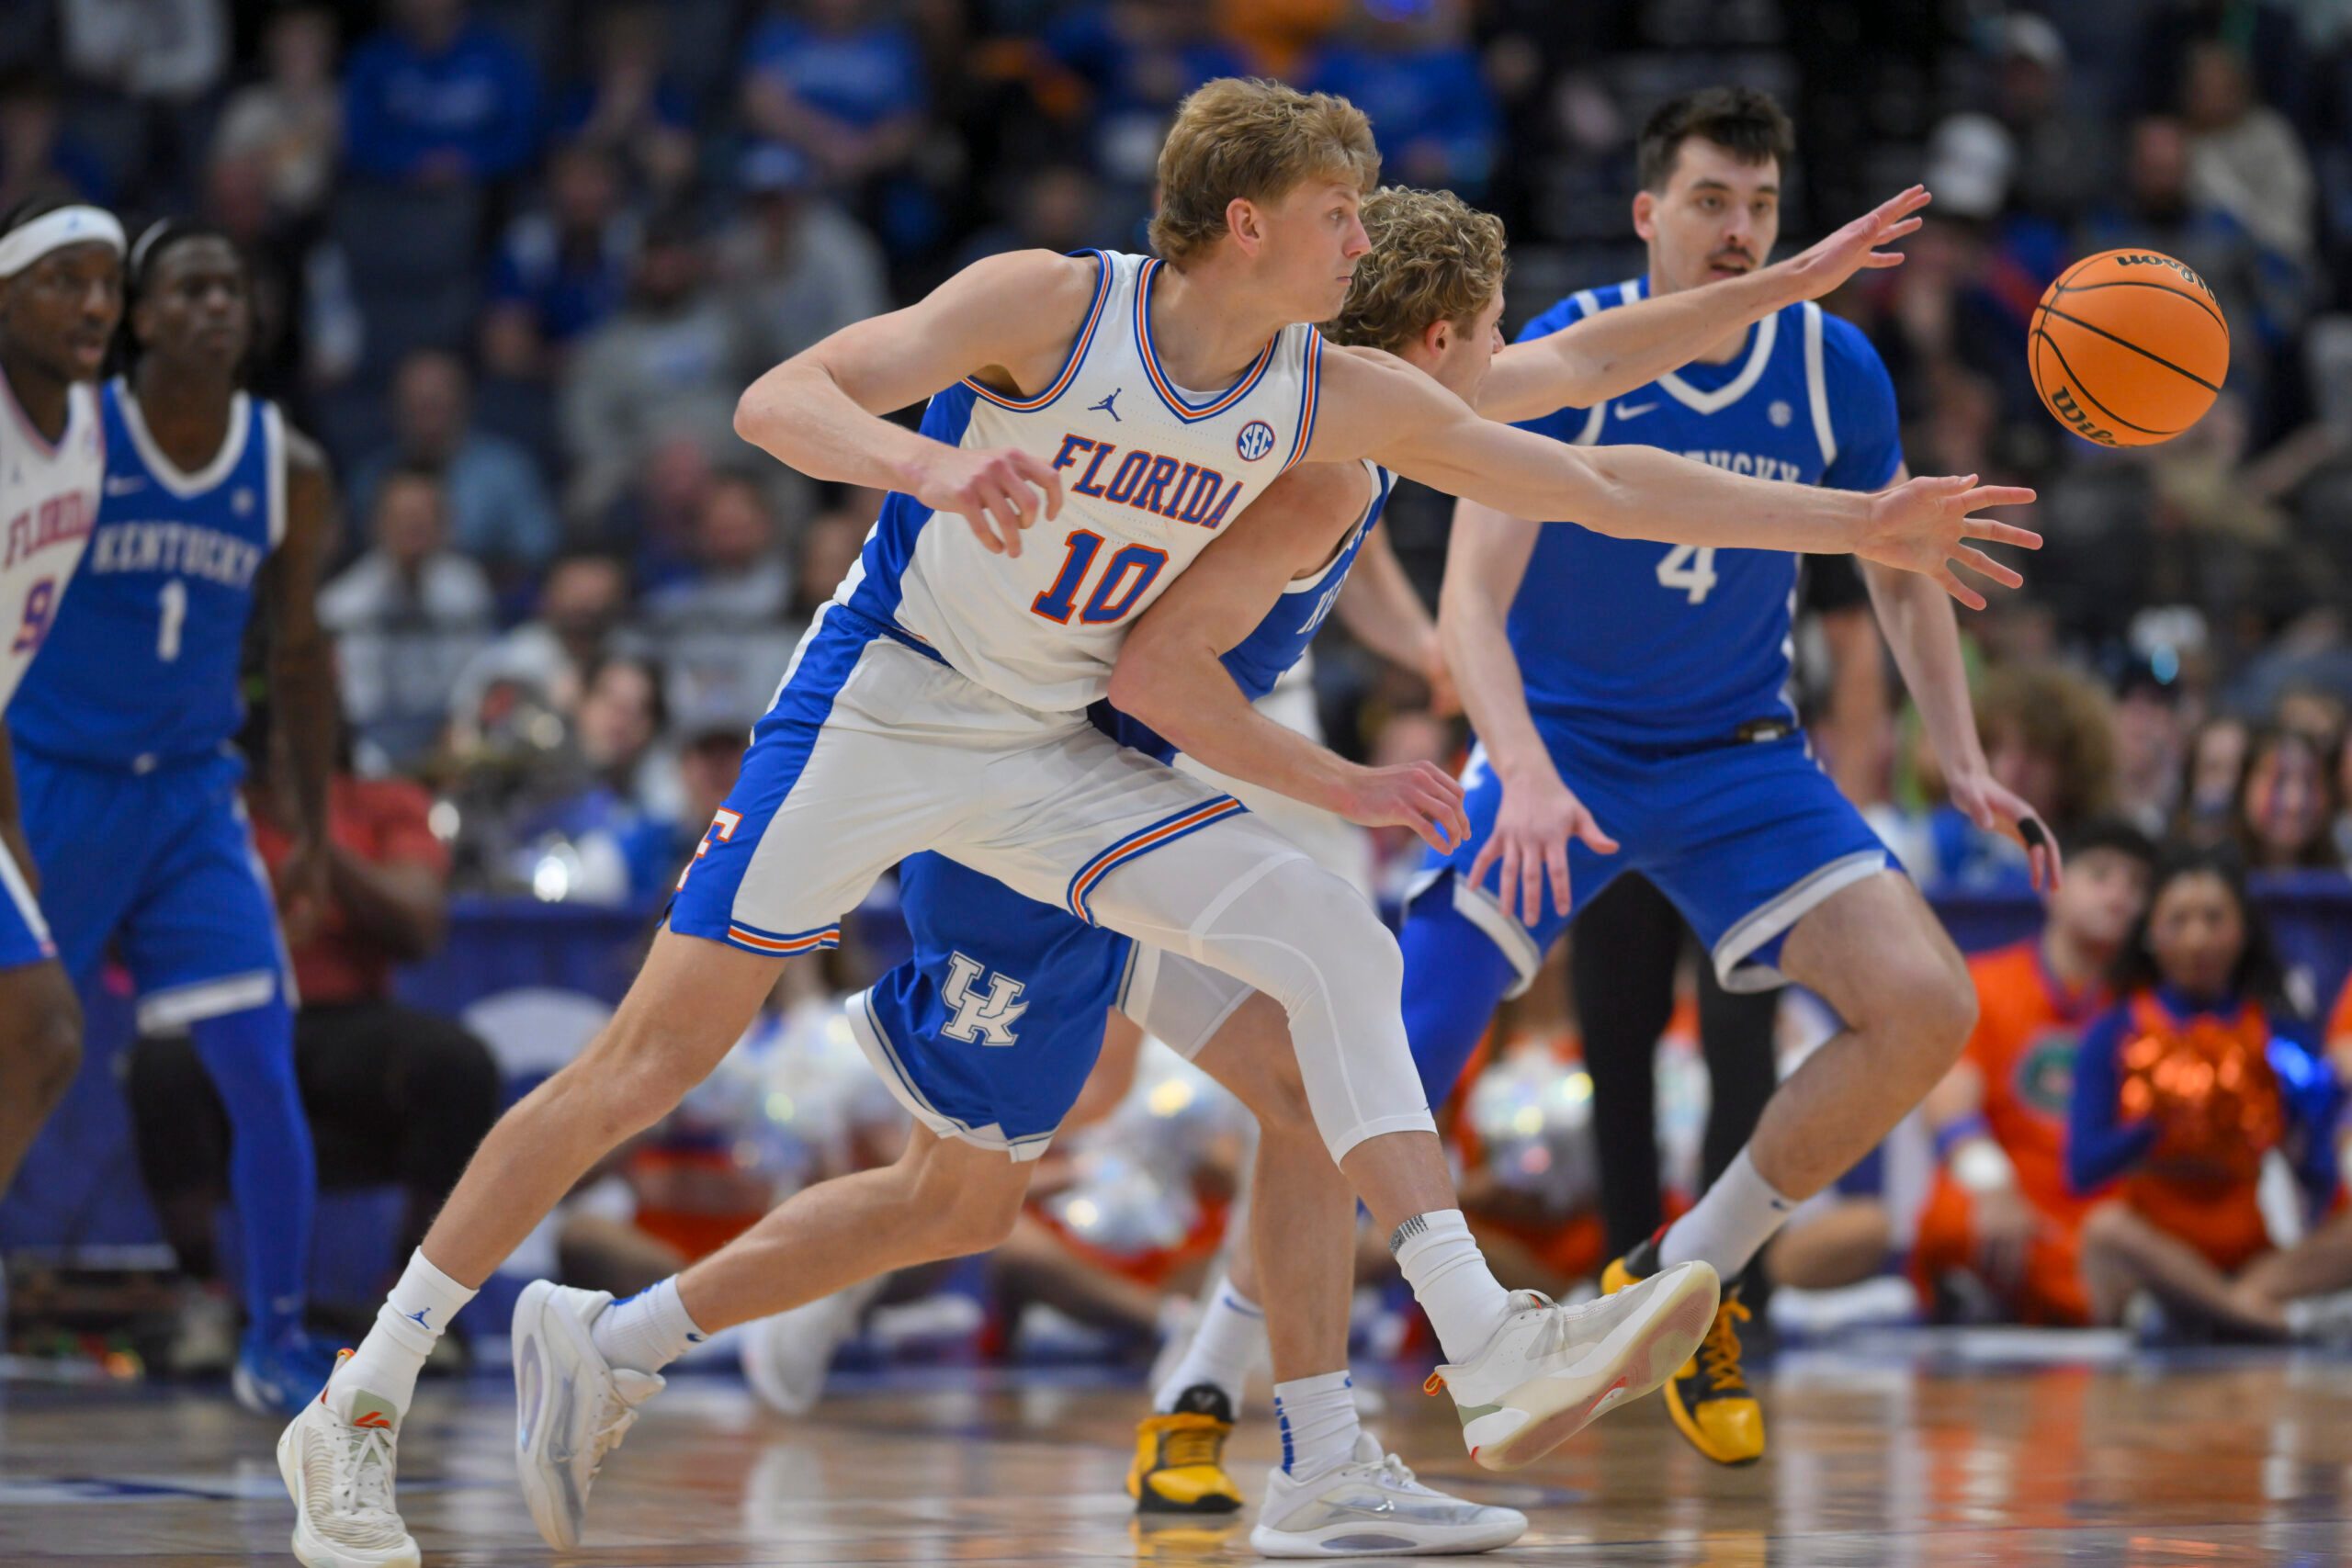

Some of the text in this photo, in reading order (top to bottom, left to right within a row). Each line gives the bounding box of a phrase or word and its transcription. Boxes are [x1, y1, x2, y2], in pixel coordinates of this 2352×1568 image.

[1052, 434, 1243, 530] FLORIDA
[1238, 423, 1273, 460] SEC
[93, 520, 263, 589] KENTUCKY
[1030, 528, 1169, 626] 10
[1656, 544, 1717, 605] 4
[10, 575, 55, 655] 9
[157, 579, 186, 661] 1
[941, 950, 1030, 1046] UK
